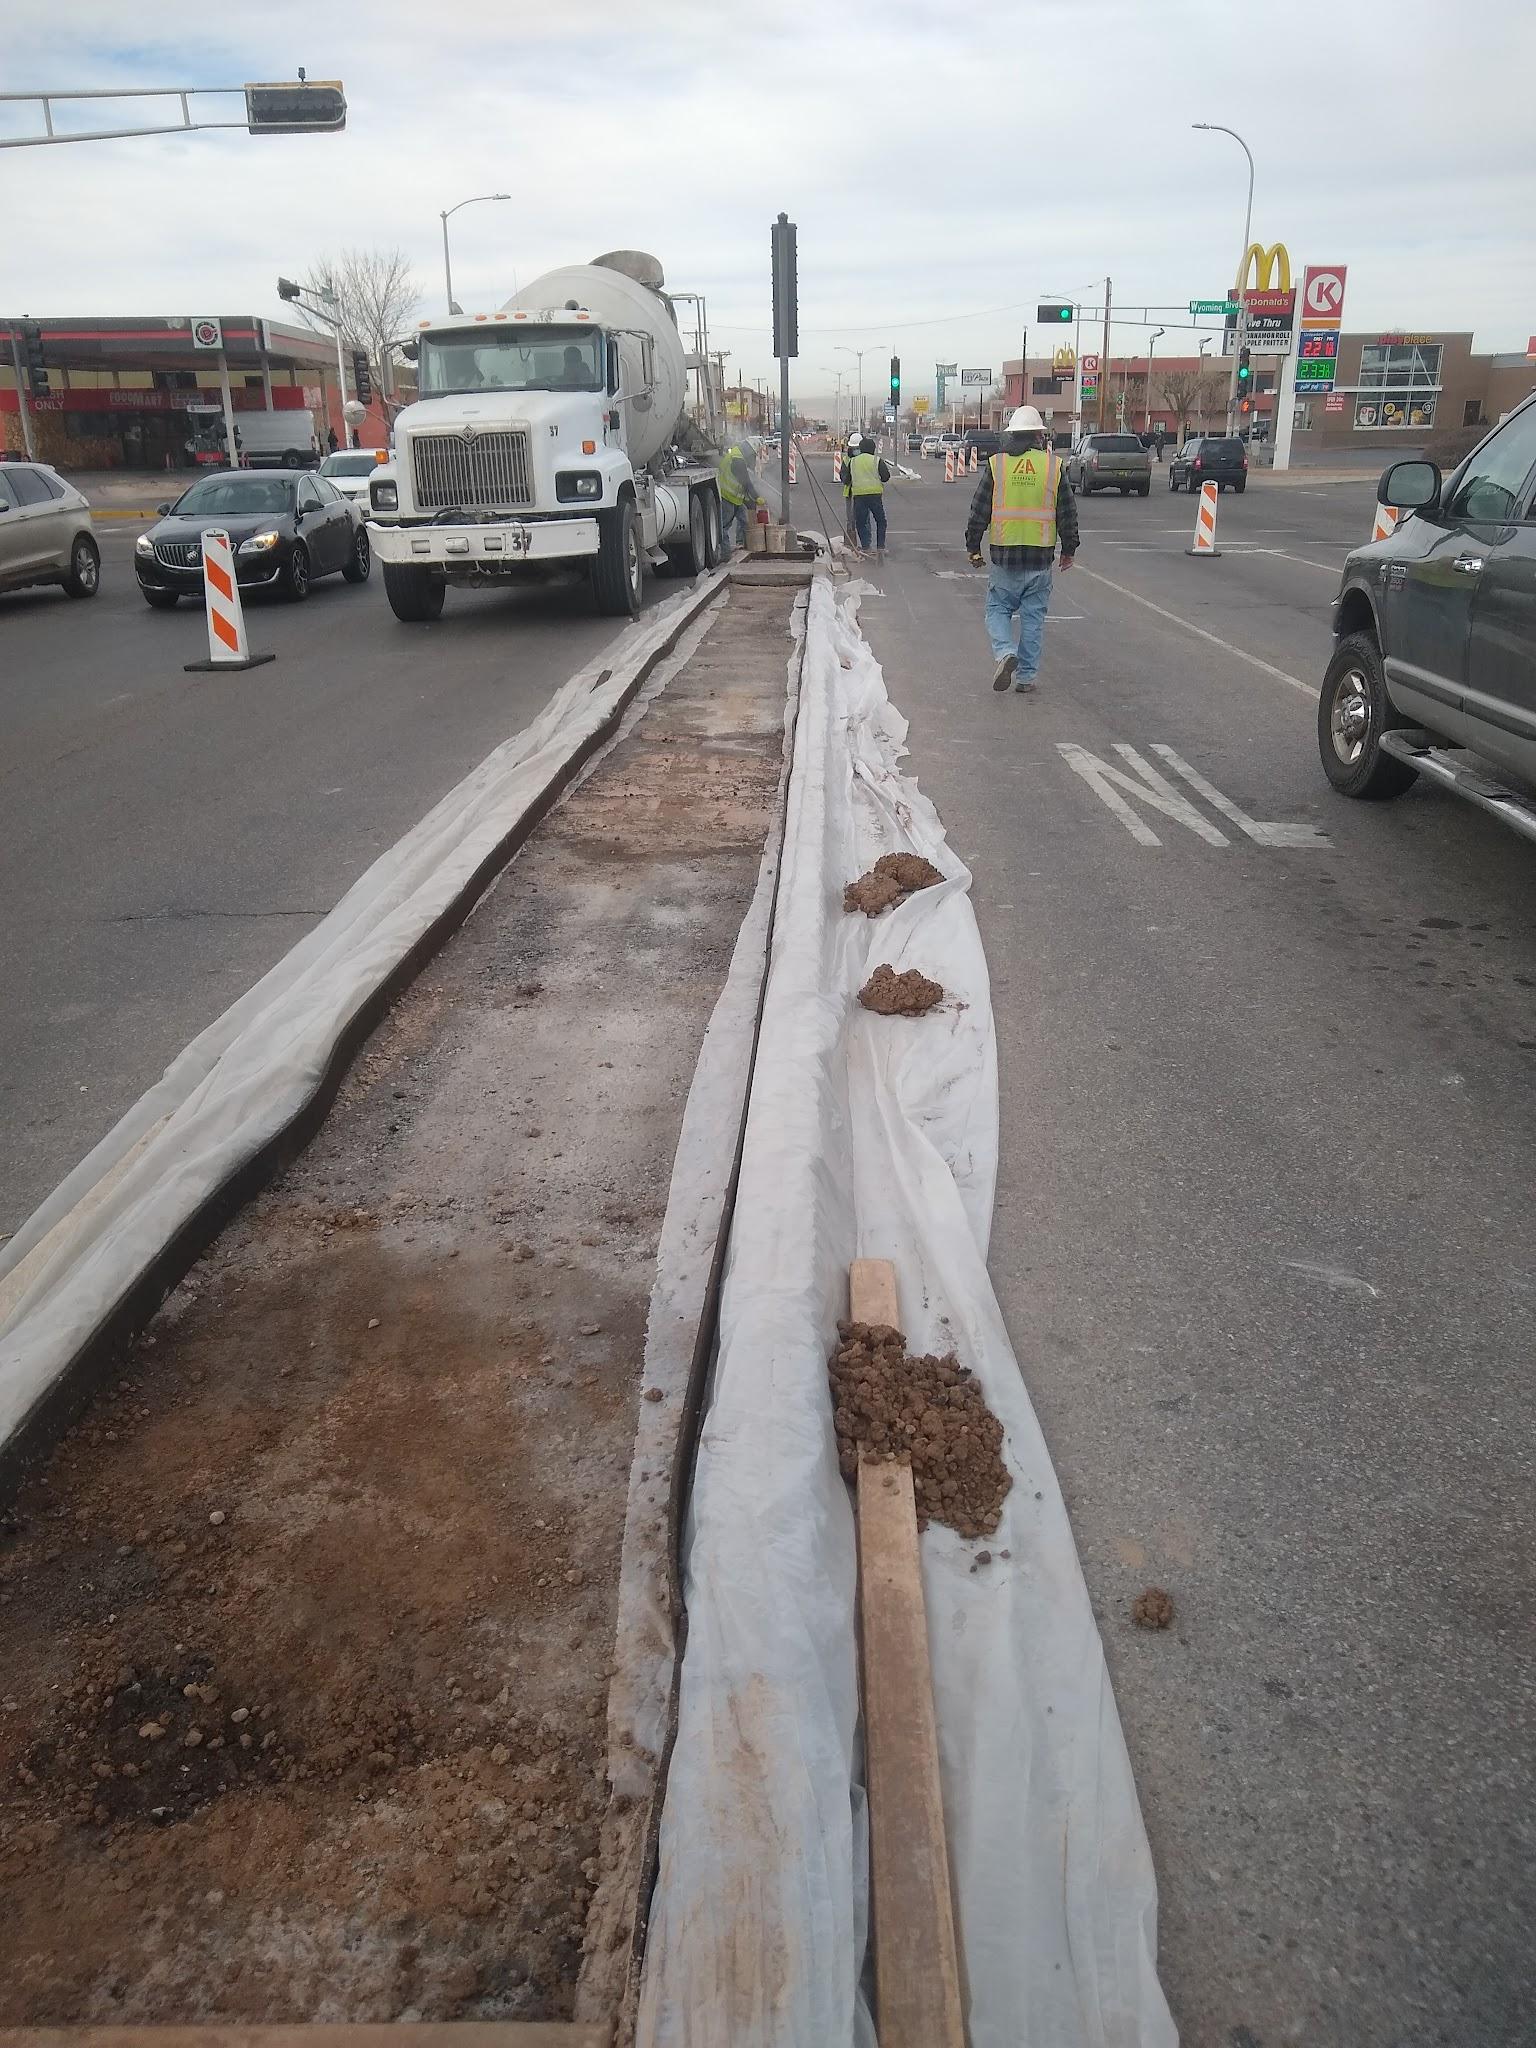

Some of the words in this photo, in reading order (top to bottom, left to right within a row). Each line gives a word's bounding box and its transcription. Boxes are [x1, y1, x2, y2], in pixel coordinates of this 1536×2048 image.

[1316, 282, 1338, 307] K
[1190, 301, 1223, 313] Wyoming
[1225, 301, 1239, 309] Blvd
[1246, 298, 1289, 306] cDonald's
[1262, 318, 1281, 327] Thru
[34, 400, 64, 410] ONLY
[512, 532, 532, 551] 37
